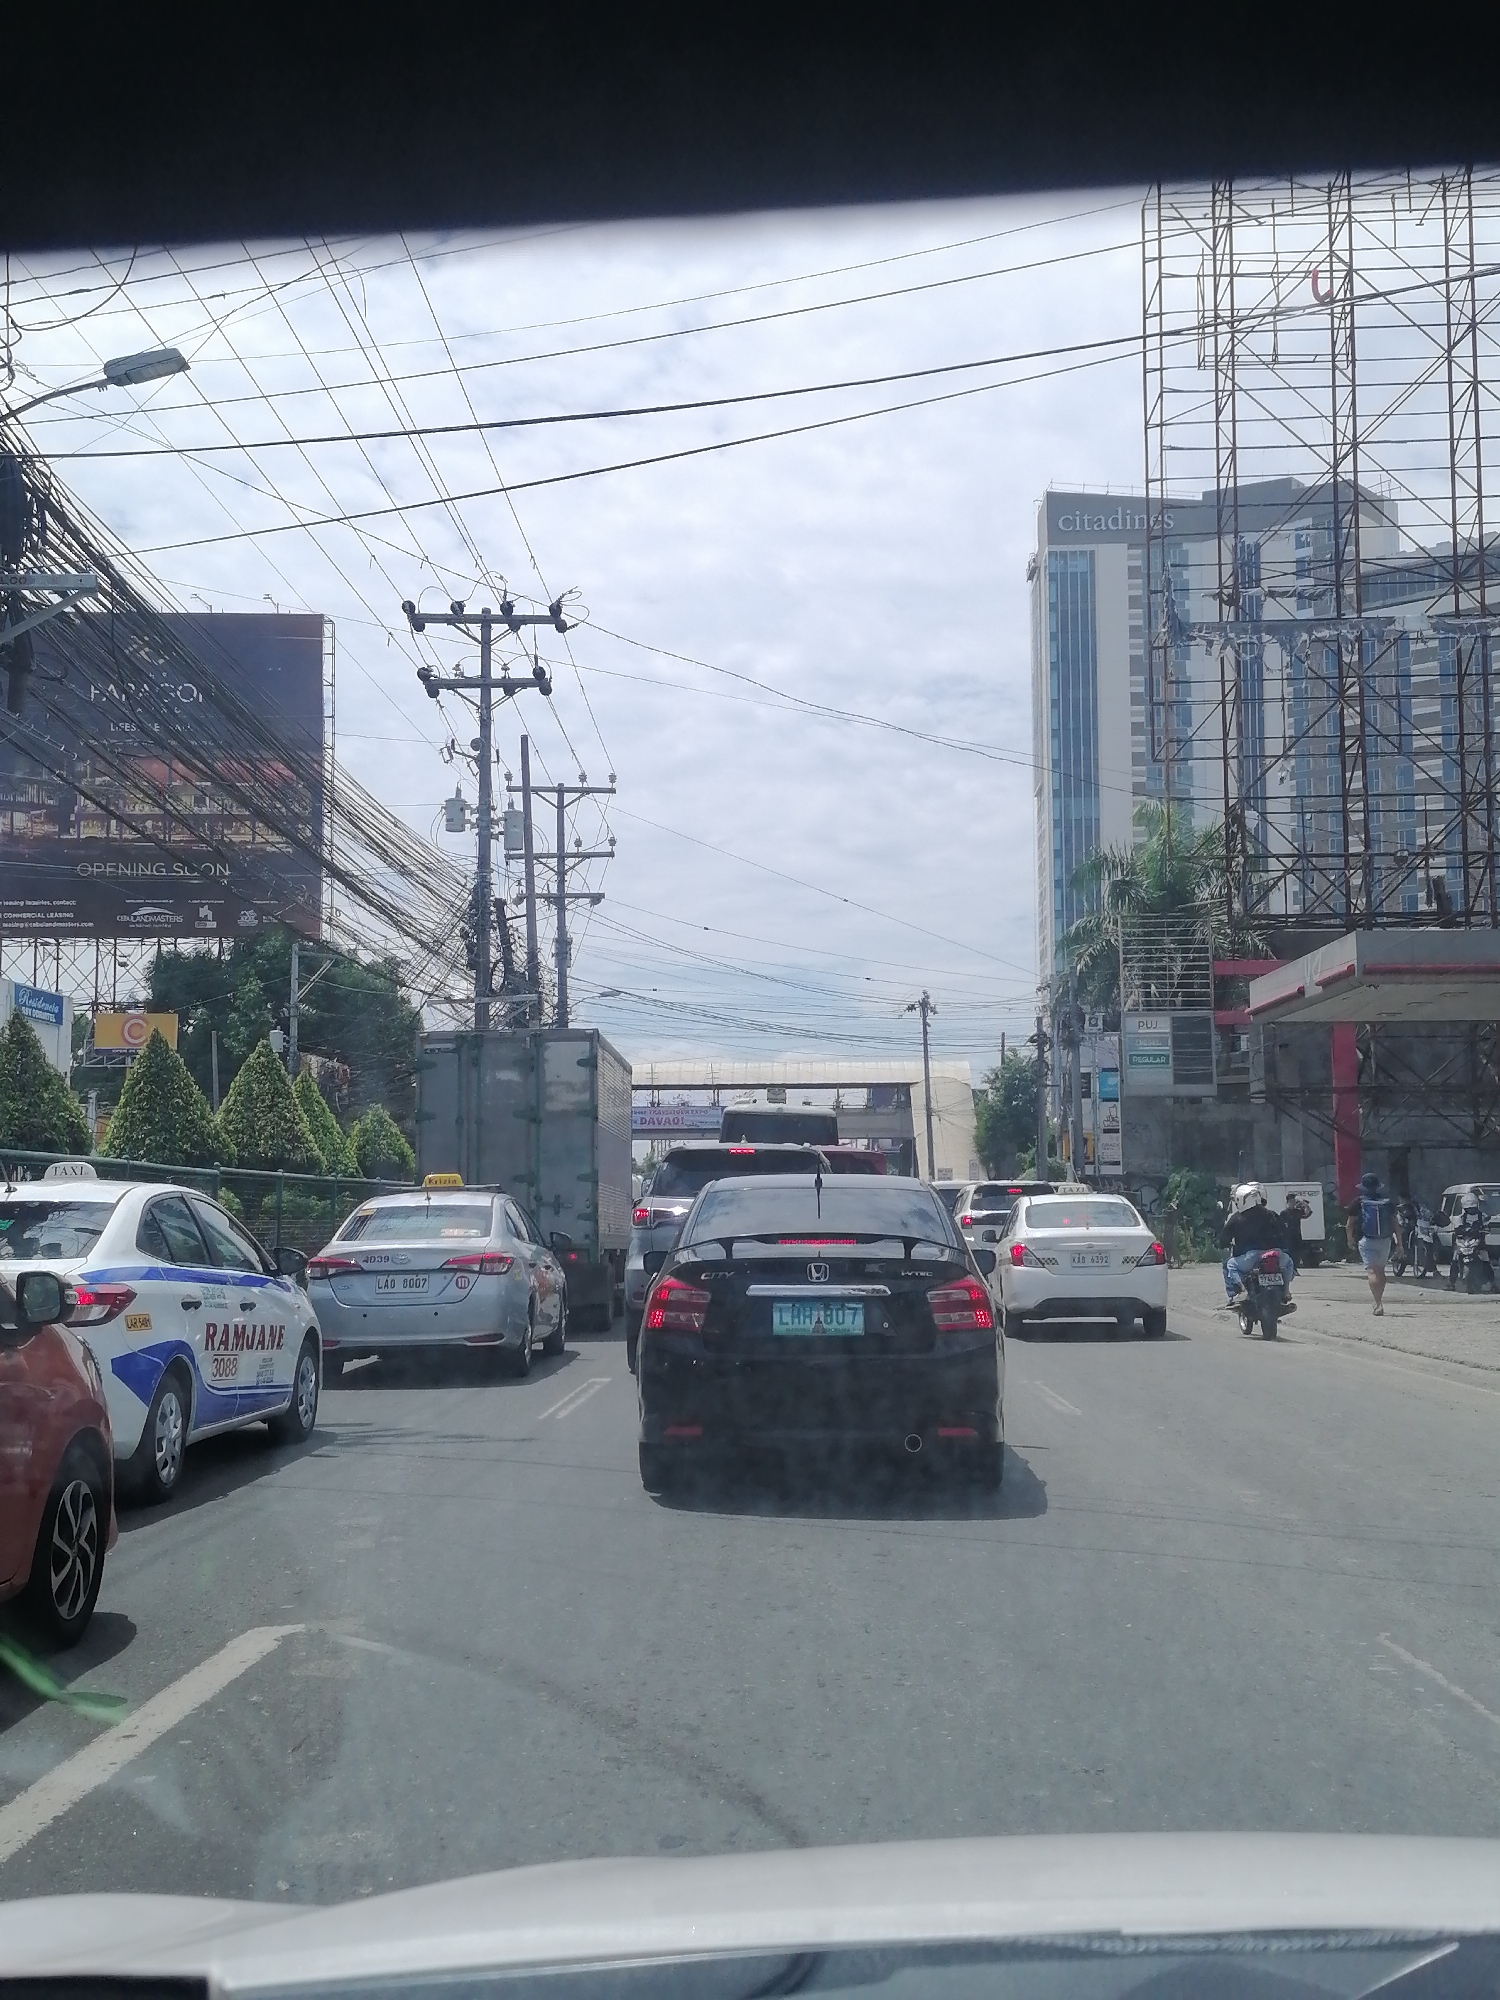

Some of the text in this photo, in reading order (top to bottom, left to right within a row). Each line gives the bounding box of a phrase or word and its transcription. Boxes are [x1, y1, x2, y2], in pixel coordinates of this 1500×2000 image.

[1058, 507, 1175, 531] citadines
[77, 862, 167, 877] OPENING
[1138, 1020, 1158, 1029] PUJ
[51, 1165, 84, 1177] TAXI
[427, 1177, 457, 1185] Krizia
[701, 1271, 735, 1280] CITY
[402, 1278, 428, 1289] 8007
[204, 1322, 286, 1352] RAMJANE
[211, 1357, 238, 1378] 3088
